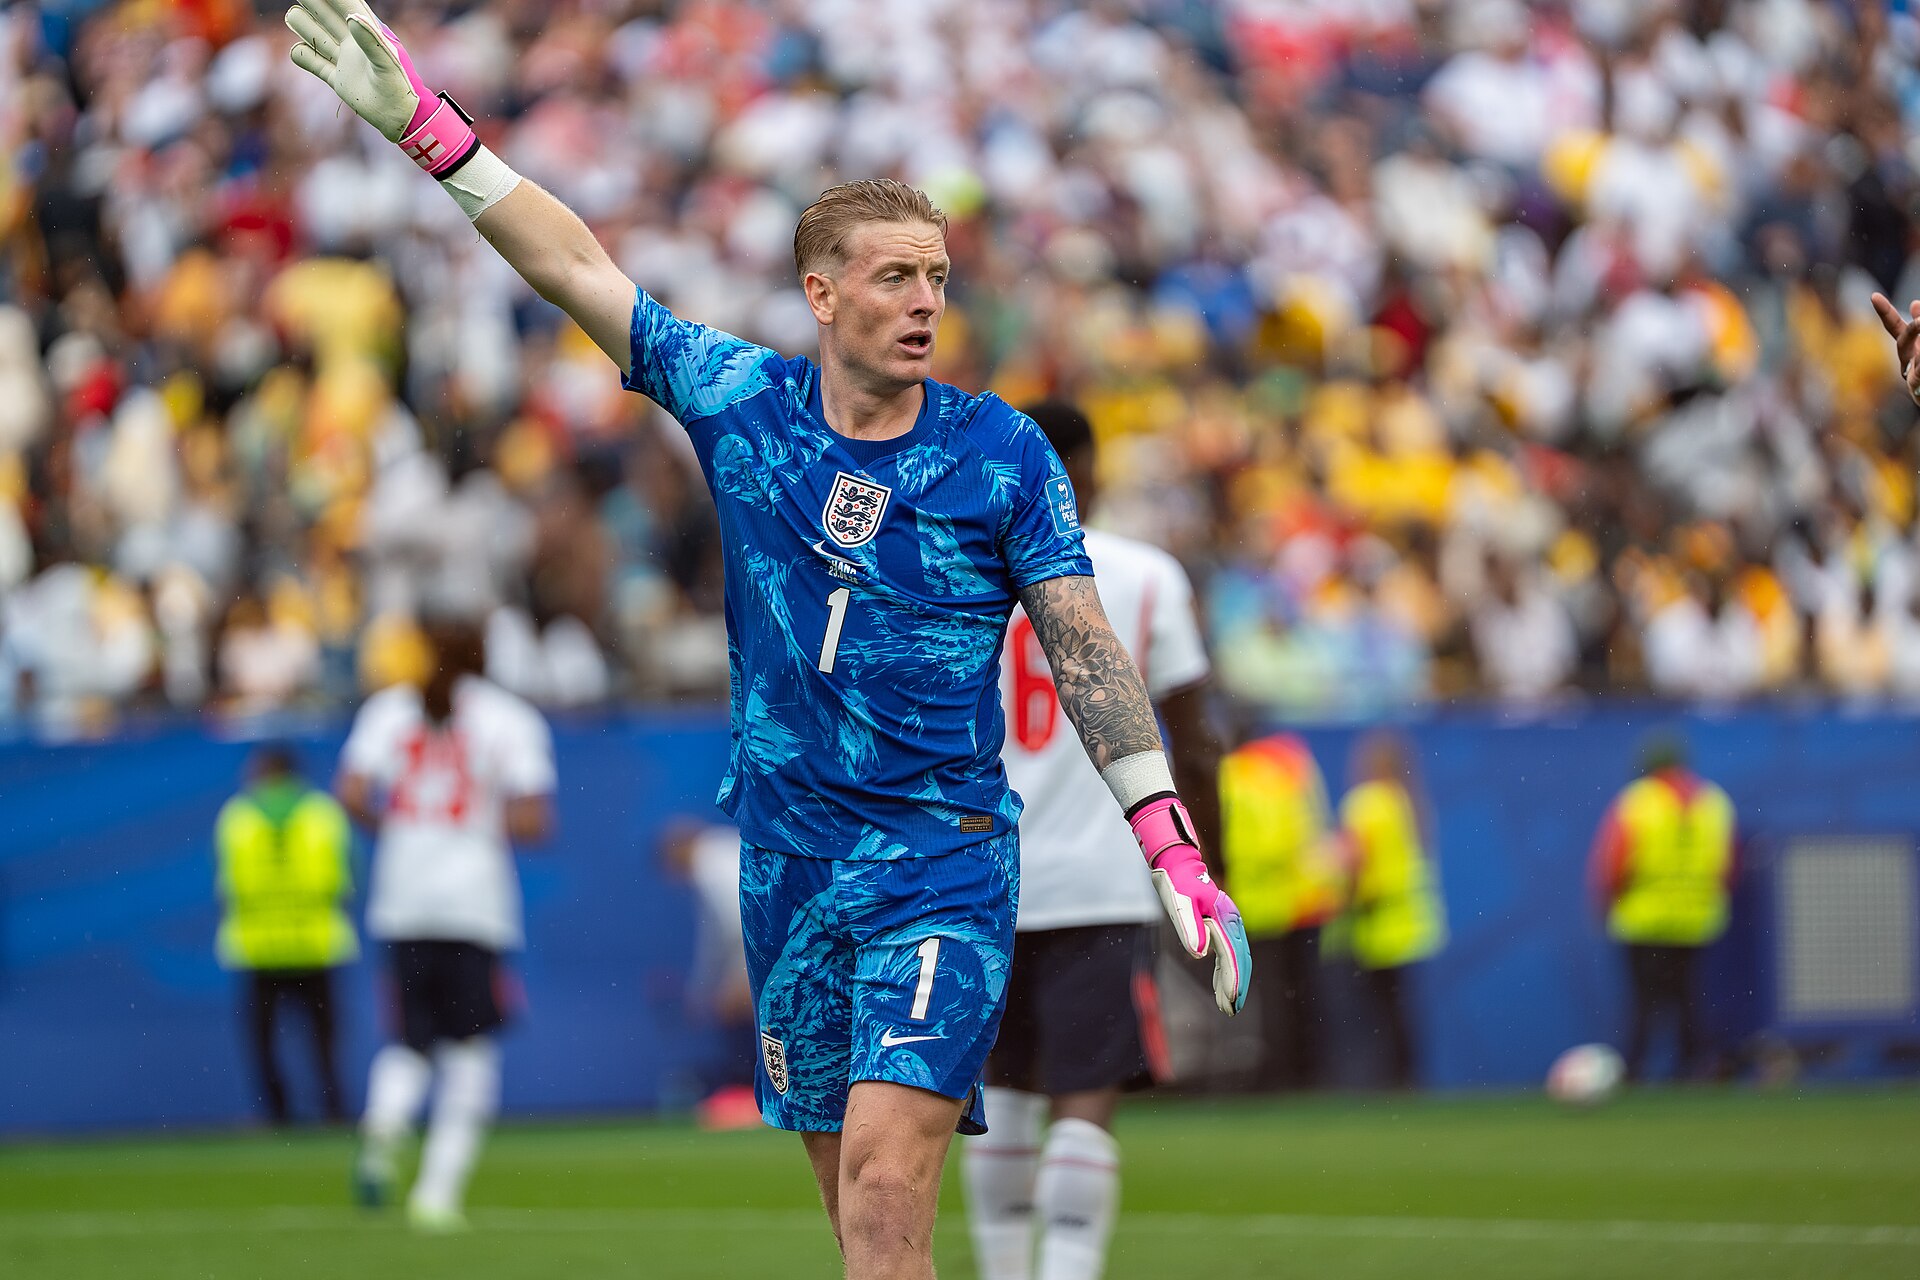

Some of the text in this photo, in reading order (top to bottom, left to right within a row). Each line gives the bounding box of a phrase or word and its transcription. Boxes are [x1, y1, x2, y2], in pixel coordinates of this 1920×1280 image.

[827, 560, 857, 575] HANA
[818, 586, 851, 675] 1
[1013, 614, 1059, 752] 6
[910, 937, 942, 1021] 1
